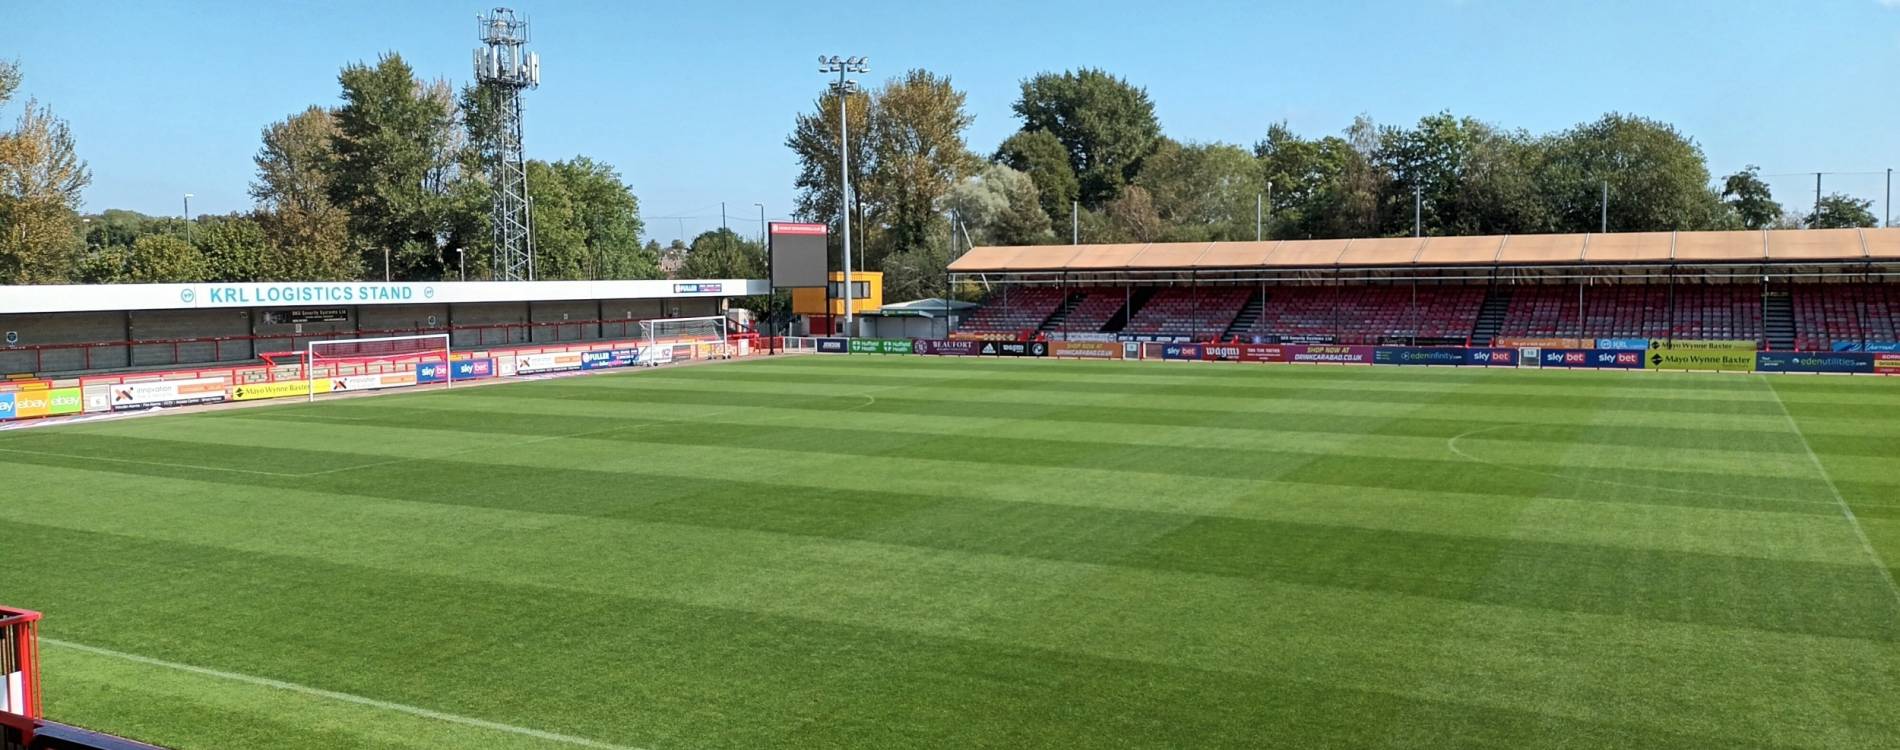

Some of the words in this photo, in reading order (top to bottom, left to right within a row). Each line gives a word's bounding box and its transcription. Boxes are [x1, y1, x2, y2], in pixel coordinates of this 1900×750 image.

[210, 287, 249, 303] KRL
[256, 286, 353, 302] LOGISTICS
[359, 286, 412, 300] STAND
[1167, 347, 1180, 355] sky
[1182, 347, 1196, 355] bet
[1206, 347, 1239, 357] wagmi
[1474, 352, 1490, 361] sky
[1492, 352, 1509, 360] bet
[1547, 352, 1564, 362] sky
[1566, 353, 1584, 361] bet
[1598, 353, 1616, 363] sky
[1619, 353, 1636, 361] bet
[1665, 356, 1689, 364] Mayo
[1690, 356, 1720, 364] Wynne
[1722, 356, 1750, 364] Baxter
[421, 367, 435, 376] sky
[436, 366, 447, 374] be
[461, 364, 474, 373] sky
[474, 362, 487, 371] bet
[17, 399, 48, 410] ebay
[50, 395, 80, 406] ebay
[0, 401, 14, 412] ay
